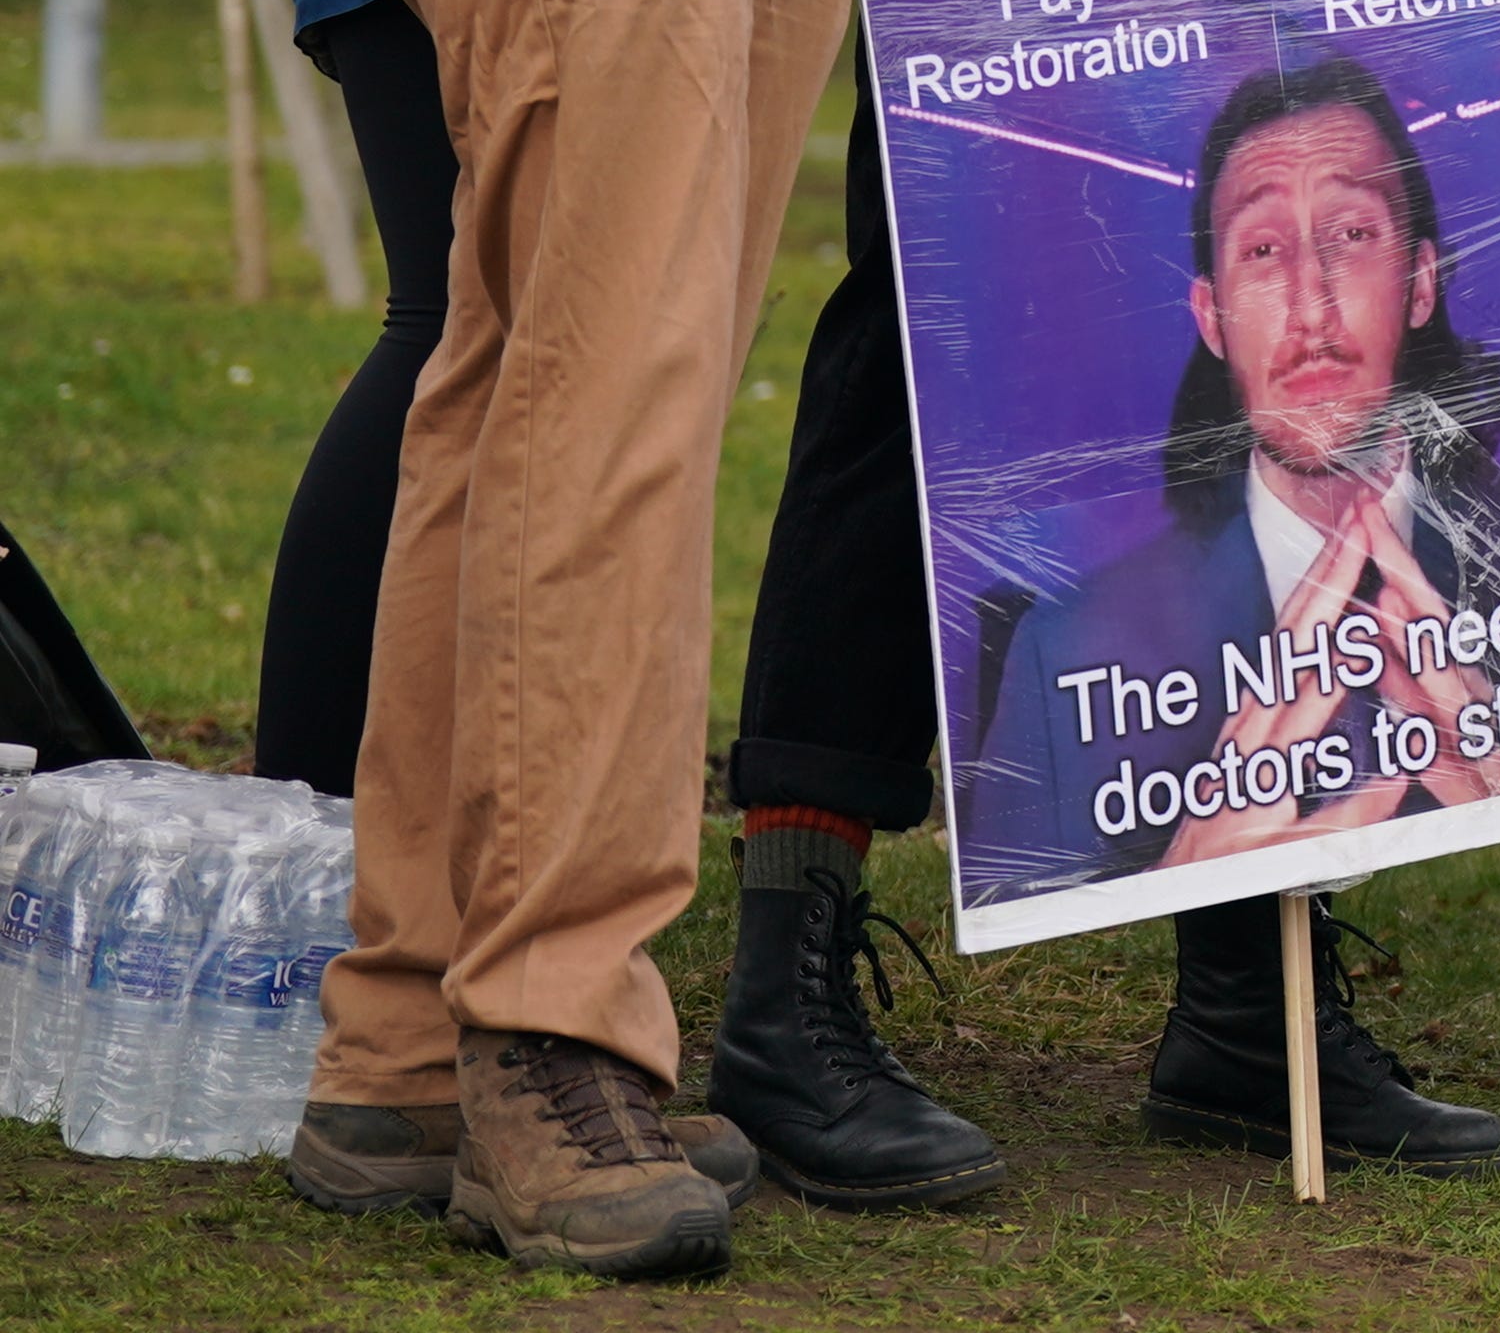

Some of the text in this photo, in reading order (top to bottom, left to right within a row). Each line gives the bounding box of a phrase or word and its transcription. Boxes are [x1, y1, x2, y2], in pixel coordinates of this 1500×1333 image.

[905, 18, 1208, 108] Restoration
[1058, 667, 1199, 742] The
[1221, 614, 1385, 714] NHS
[1092, 734, 1352, 836] doctors
[1372, 711, 1436, 776] to
